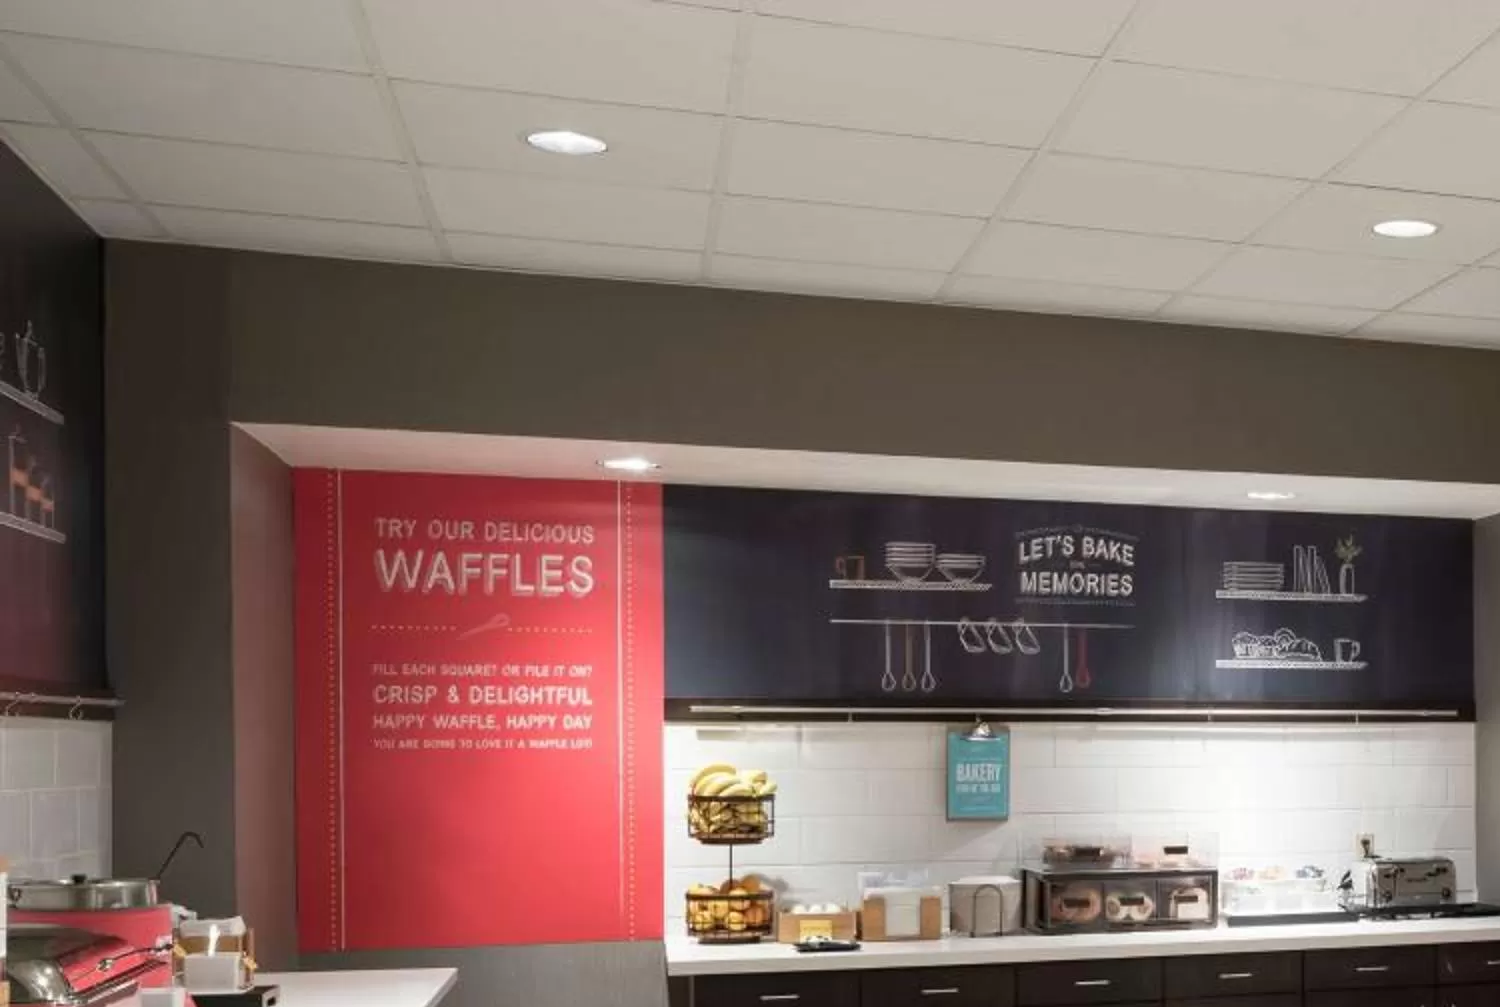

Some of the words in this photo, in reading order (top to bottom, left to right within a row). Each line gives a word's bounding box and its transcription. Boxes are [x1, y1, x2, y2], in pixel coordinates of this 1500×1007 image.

[375, 517, 417, 538] TRY
[428, 520, 475, 541] OUR
[484, 521, 594, 544] DELICIOUS
[1018, 535, 1075, 565] LET'S
[1082, 535, 1134, 566] BAKE
[374, 549, 594, 597] WAFFLES
[1020, 571, 1133, 597] MEMORIES
[402, 663, 436, 676] EACH
[373, 684, 438, 705] CRISP
[447, 684, 459, 705] &
[468, 685, 593, 706] DELIGHTFUL
[373, 713, 424, 729] HAPPY
[505, 713, 557, 730] HAPPY
[563, 714, 593, 731] DAY
[955, 763, 1001, 782] BAKERY
